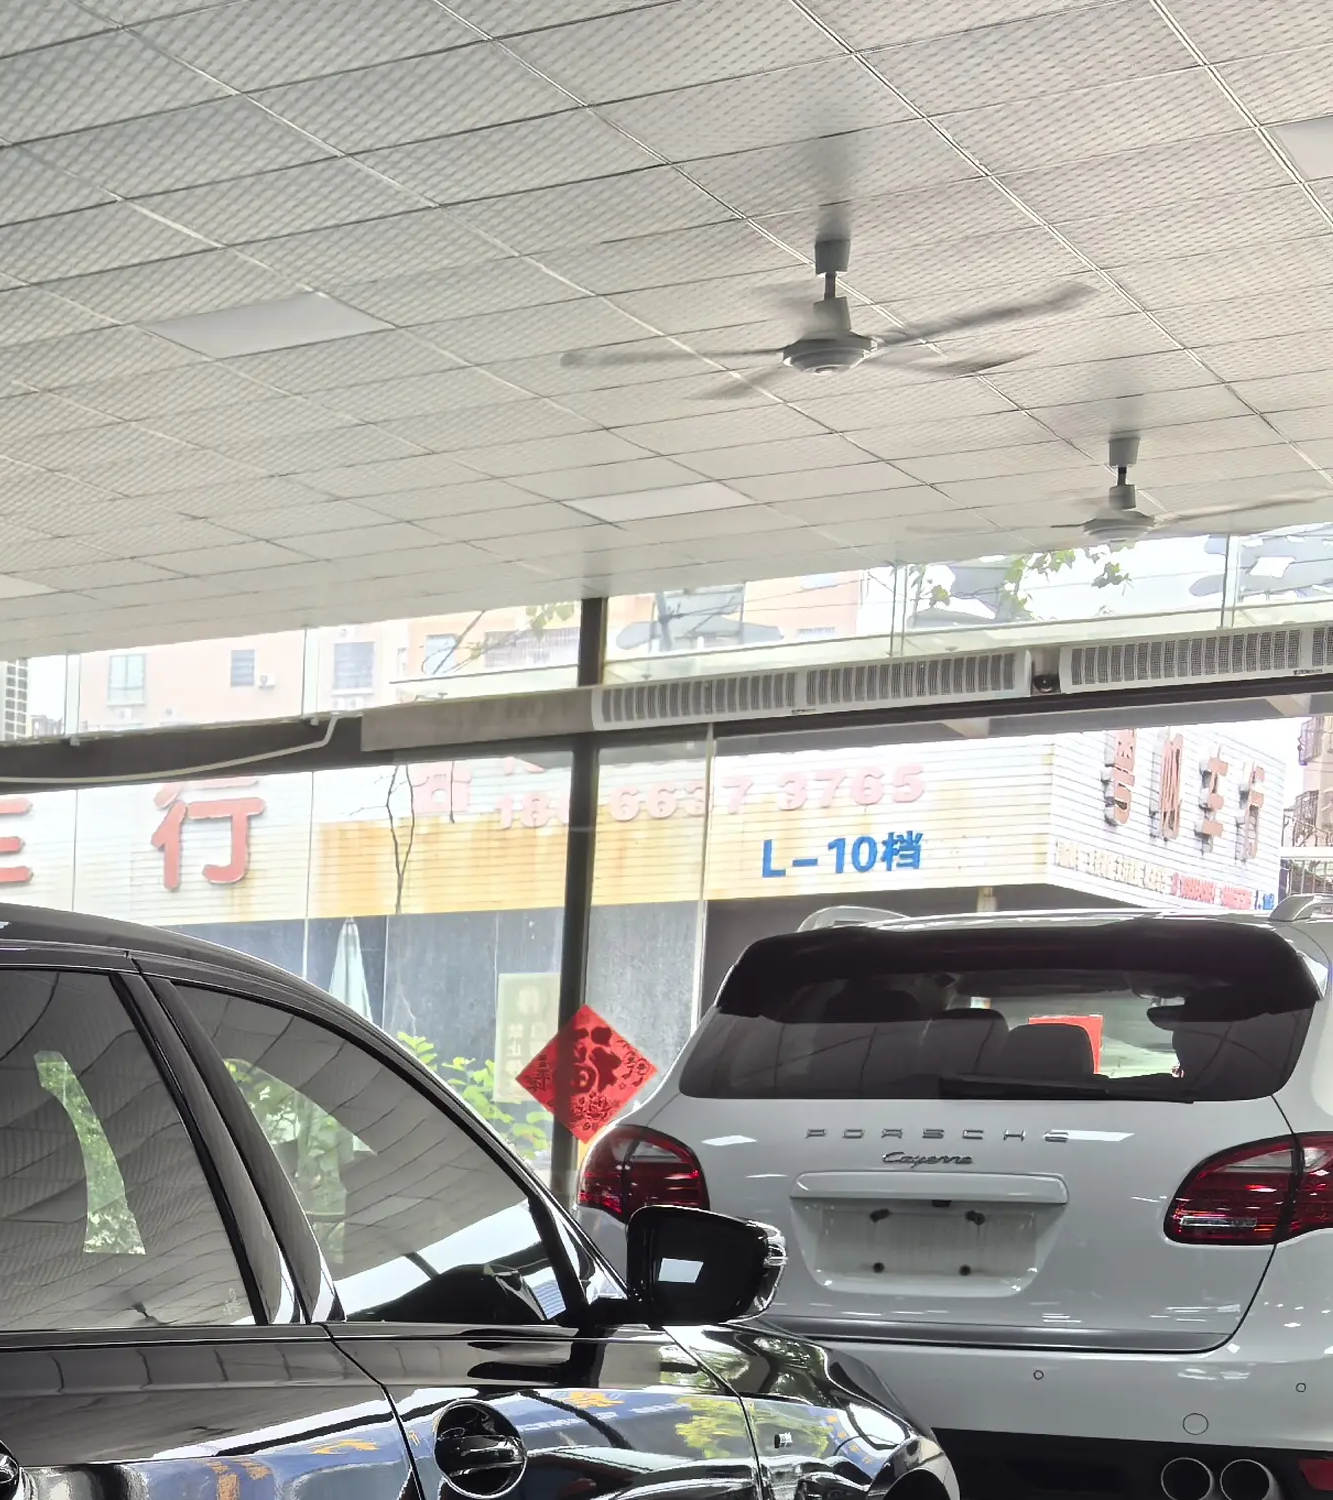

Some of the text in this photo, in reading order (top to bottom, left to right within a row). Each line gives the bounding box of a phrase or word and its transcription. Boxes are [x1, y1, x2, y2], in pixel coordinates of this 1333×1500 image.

[777, 763, 925, 811] 3765
[762, 830, 923, 878] L-10档
[805, 1128, 1070, 1142] PORSCHE
[882, 1151, 973, 1168] Cayenne
